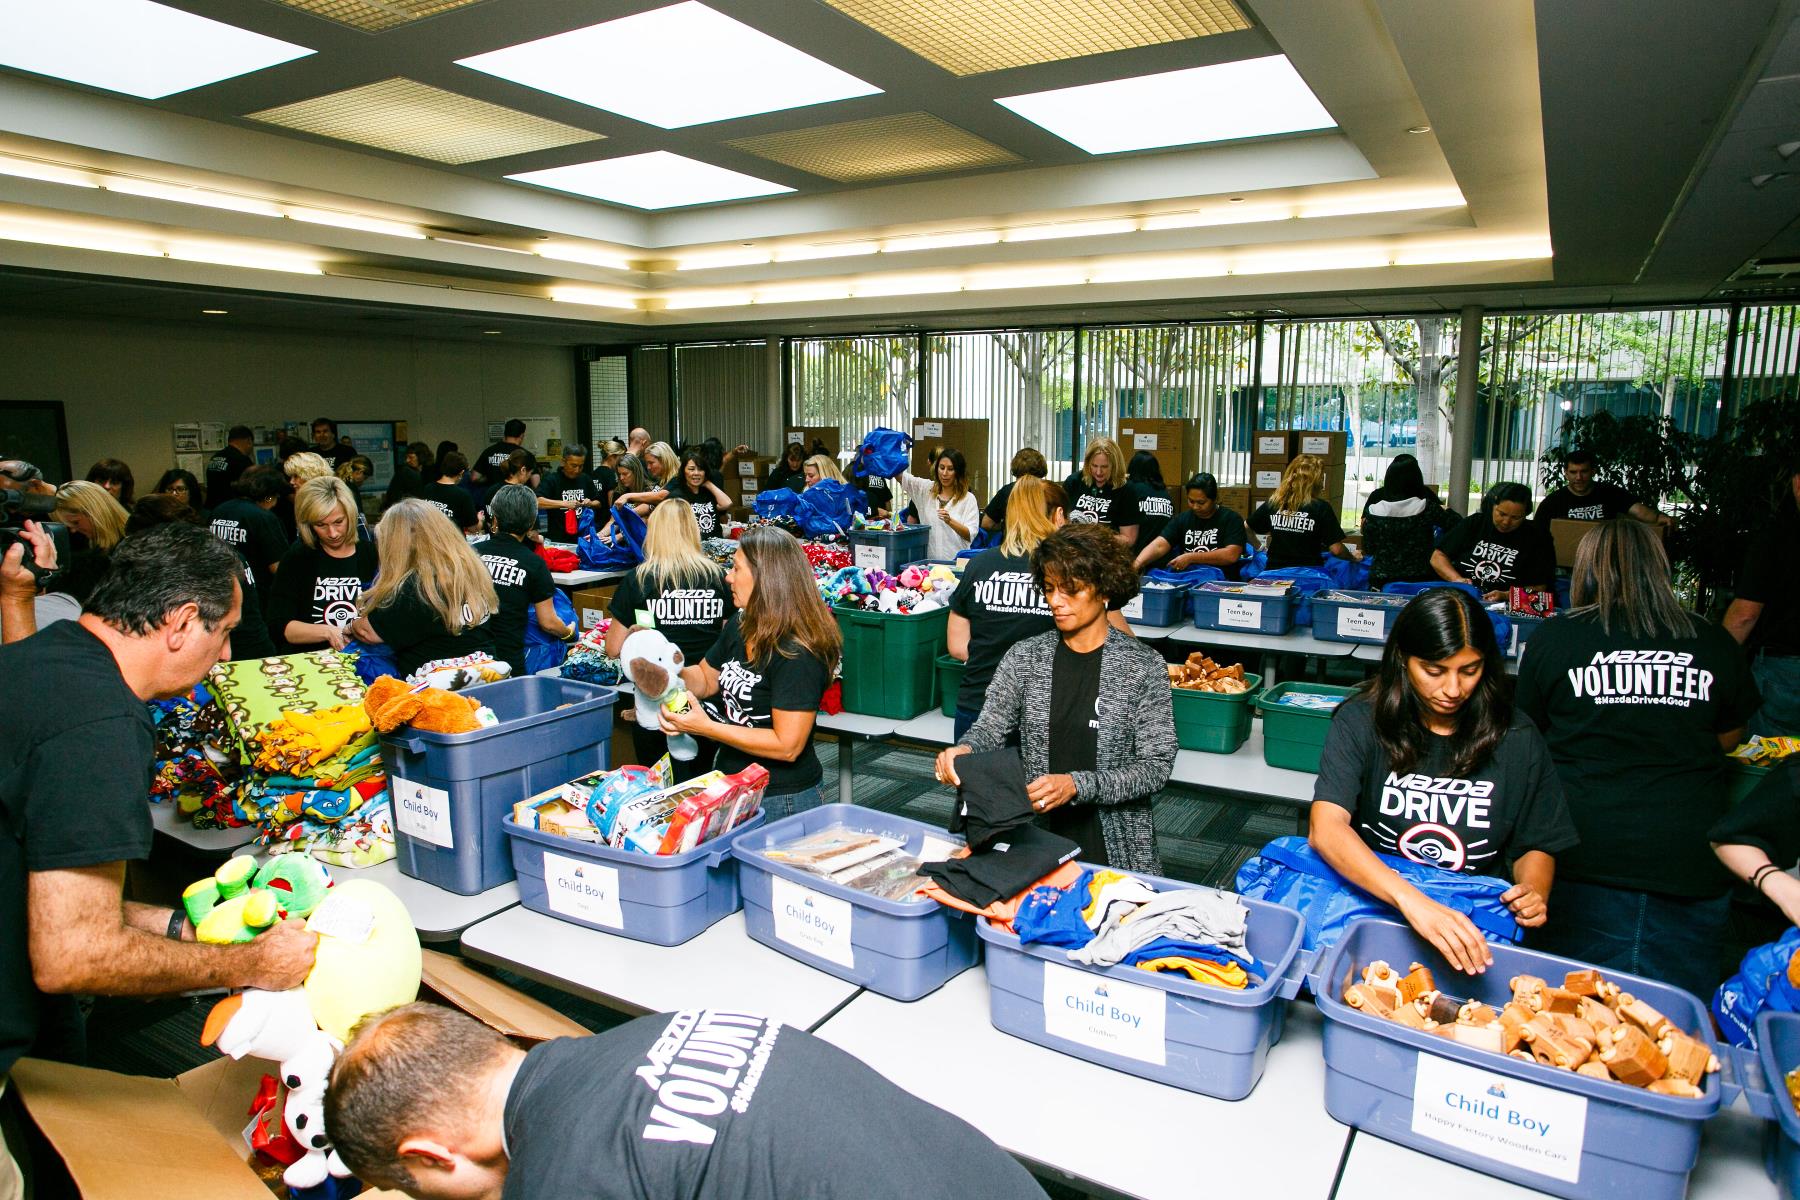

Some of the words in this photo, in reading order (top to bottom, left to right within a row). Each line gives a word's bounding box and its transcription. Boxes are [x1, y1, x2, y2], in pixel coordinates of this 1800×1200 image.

[1076, 499, 1110, 513] DRIVE
[1269, 513, 1316, 532] VOLUNTEER
[1471, 544, 1518, 568] DRIVE
[646, 598, 724, 620] VOLUNTEER
[1346, 617, 1362, 625] Teen
[1363, 619, 1376, 627] Boy
[1567, 663, 1714, 702] VOLUNTEER
[403, 799, 422, 814] Child
[423, 805, 438, 821] Boy
[1379, 786, 1492, 829] DRIVE
[558, 877, 582, 893] Child
[585, 884, 604, 901] Boy
[786, 904, 811, 925] Child
[814, 915, 835, 936] Boy
[1065, 995, 1105, 1017] Child
[1110, 1006, 1142, 1029] Boy
[642, 1009, 768, 1145] VOLUNT
[1444, 1091, 1500, 1120] Child
[1507, 1109, 1551, 1137] Boy
[1424, 1111, 1456, 1129] Happy
[1457, 1123, 1495, 1142] Factory
[1496, 1135, 1543, 1156] Wooden
[1544, 1149, 1568, 1162] Cars
